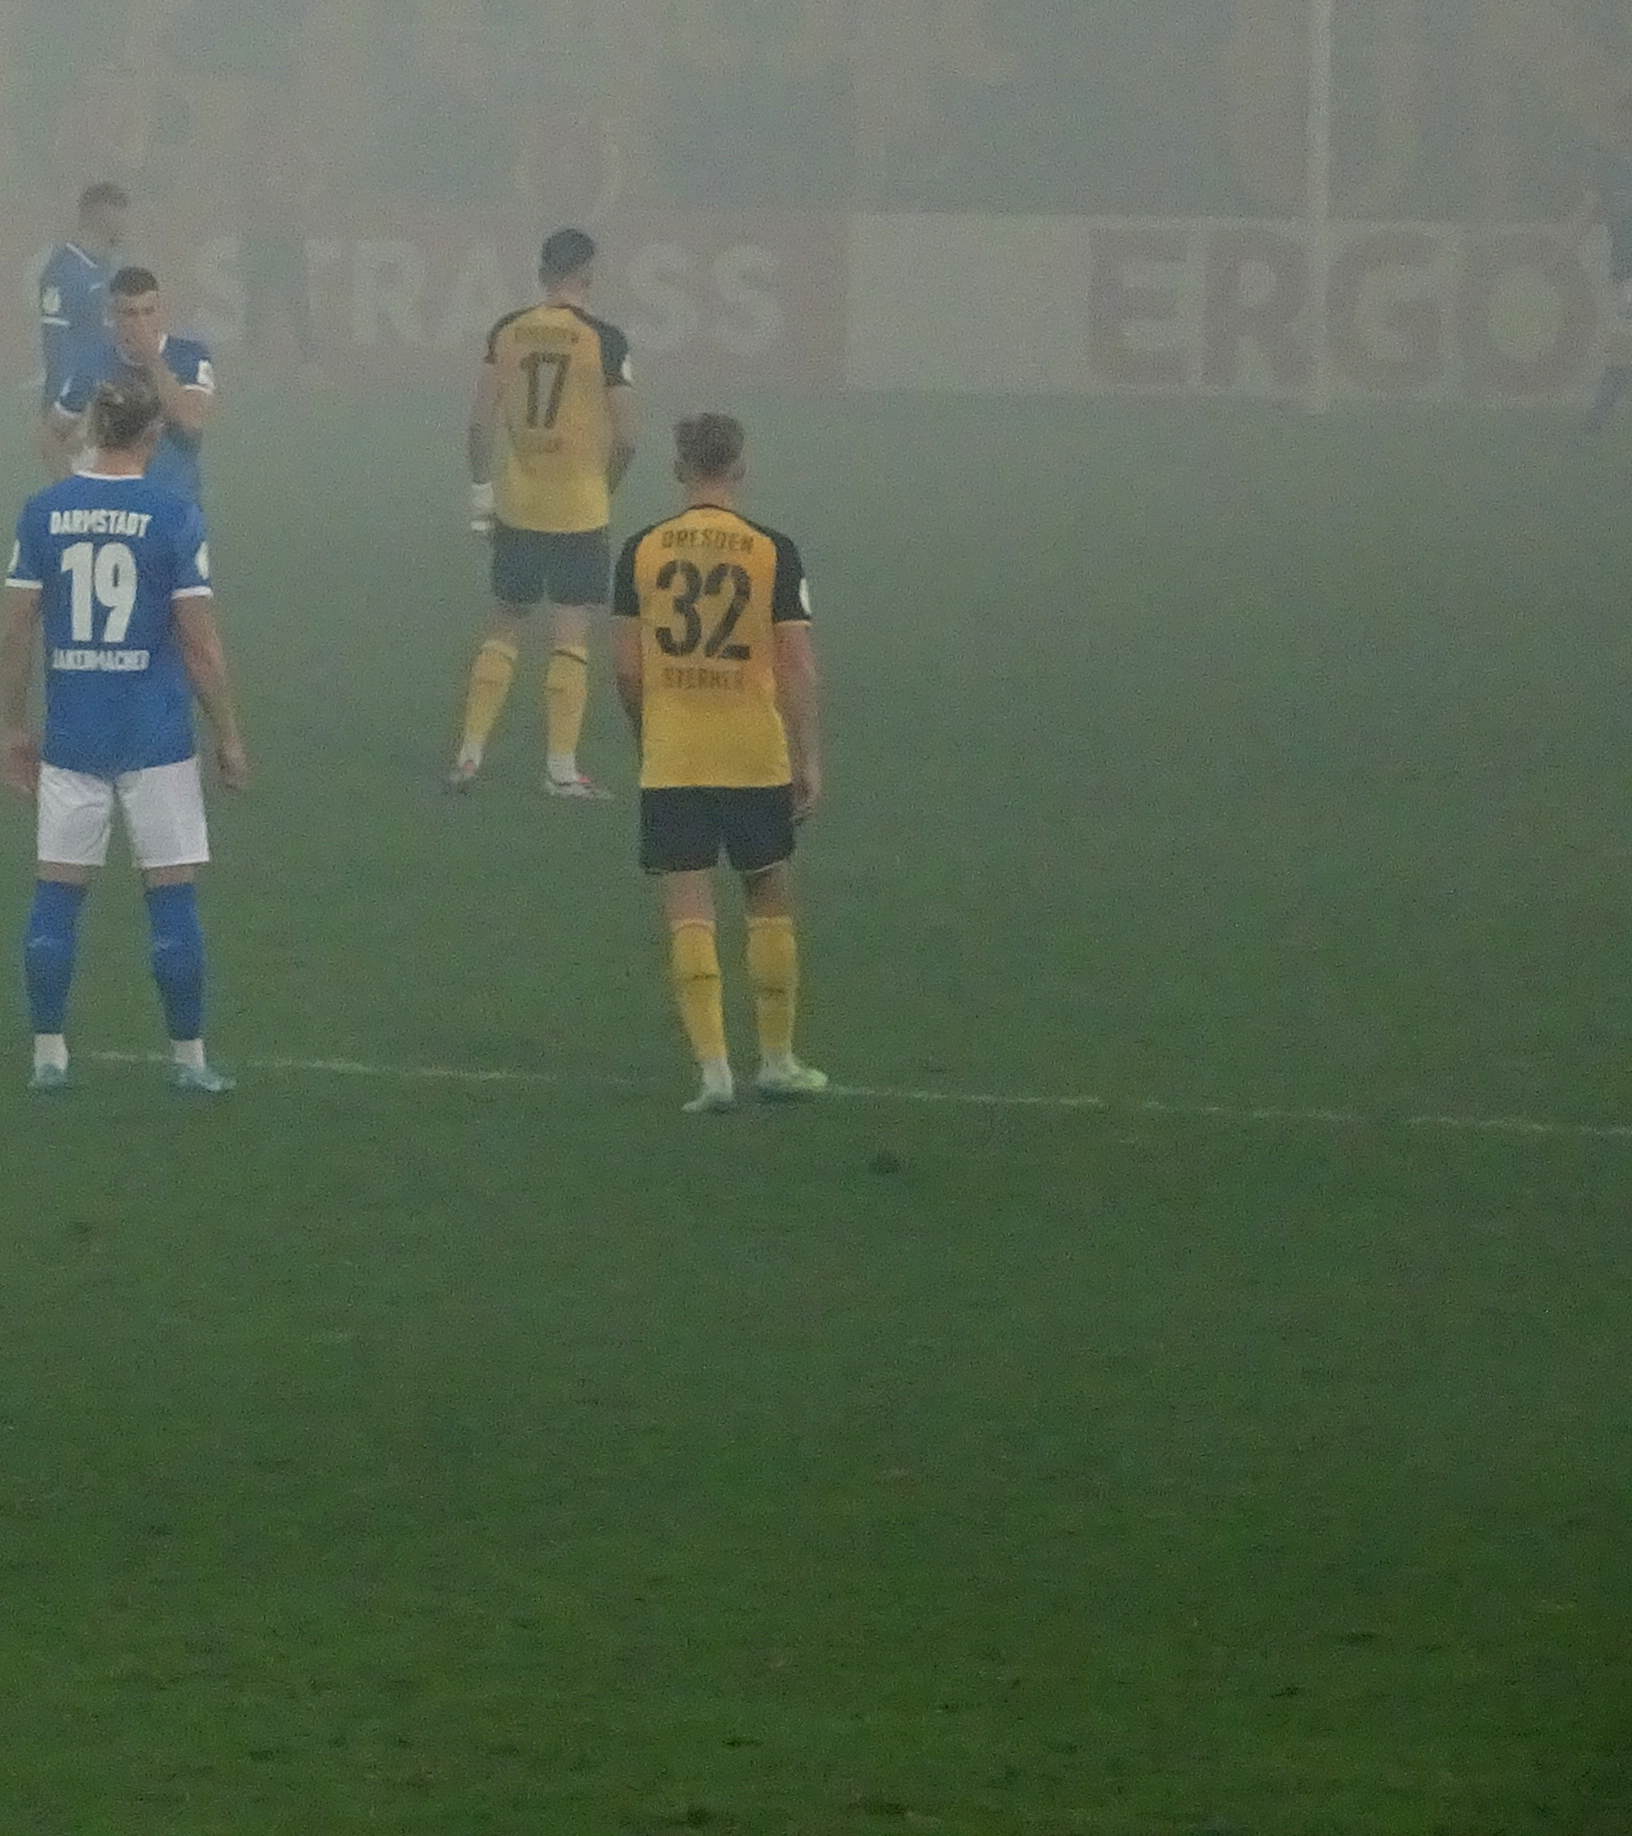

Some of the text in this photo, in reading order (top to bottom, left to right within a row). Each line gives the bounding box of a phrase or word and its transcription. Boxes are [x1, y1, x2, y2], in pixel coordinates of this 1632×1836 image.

[1089, 226, 1600, 400] ERGO
[520, 351, 571, 430] 17
[49, 509, 154, 539] DARMSTADT
[662, 528, 755, 555] DRESDEN
[60, 540, 138, 644] 19
[655, 558, 752, 661] 32
